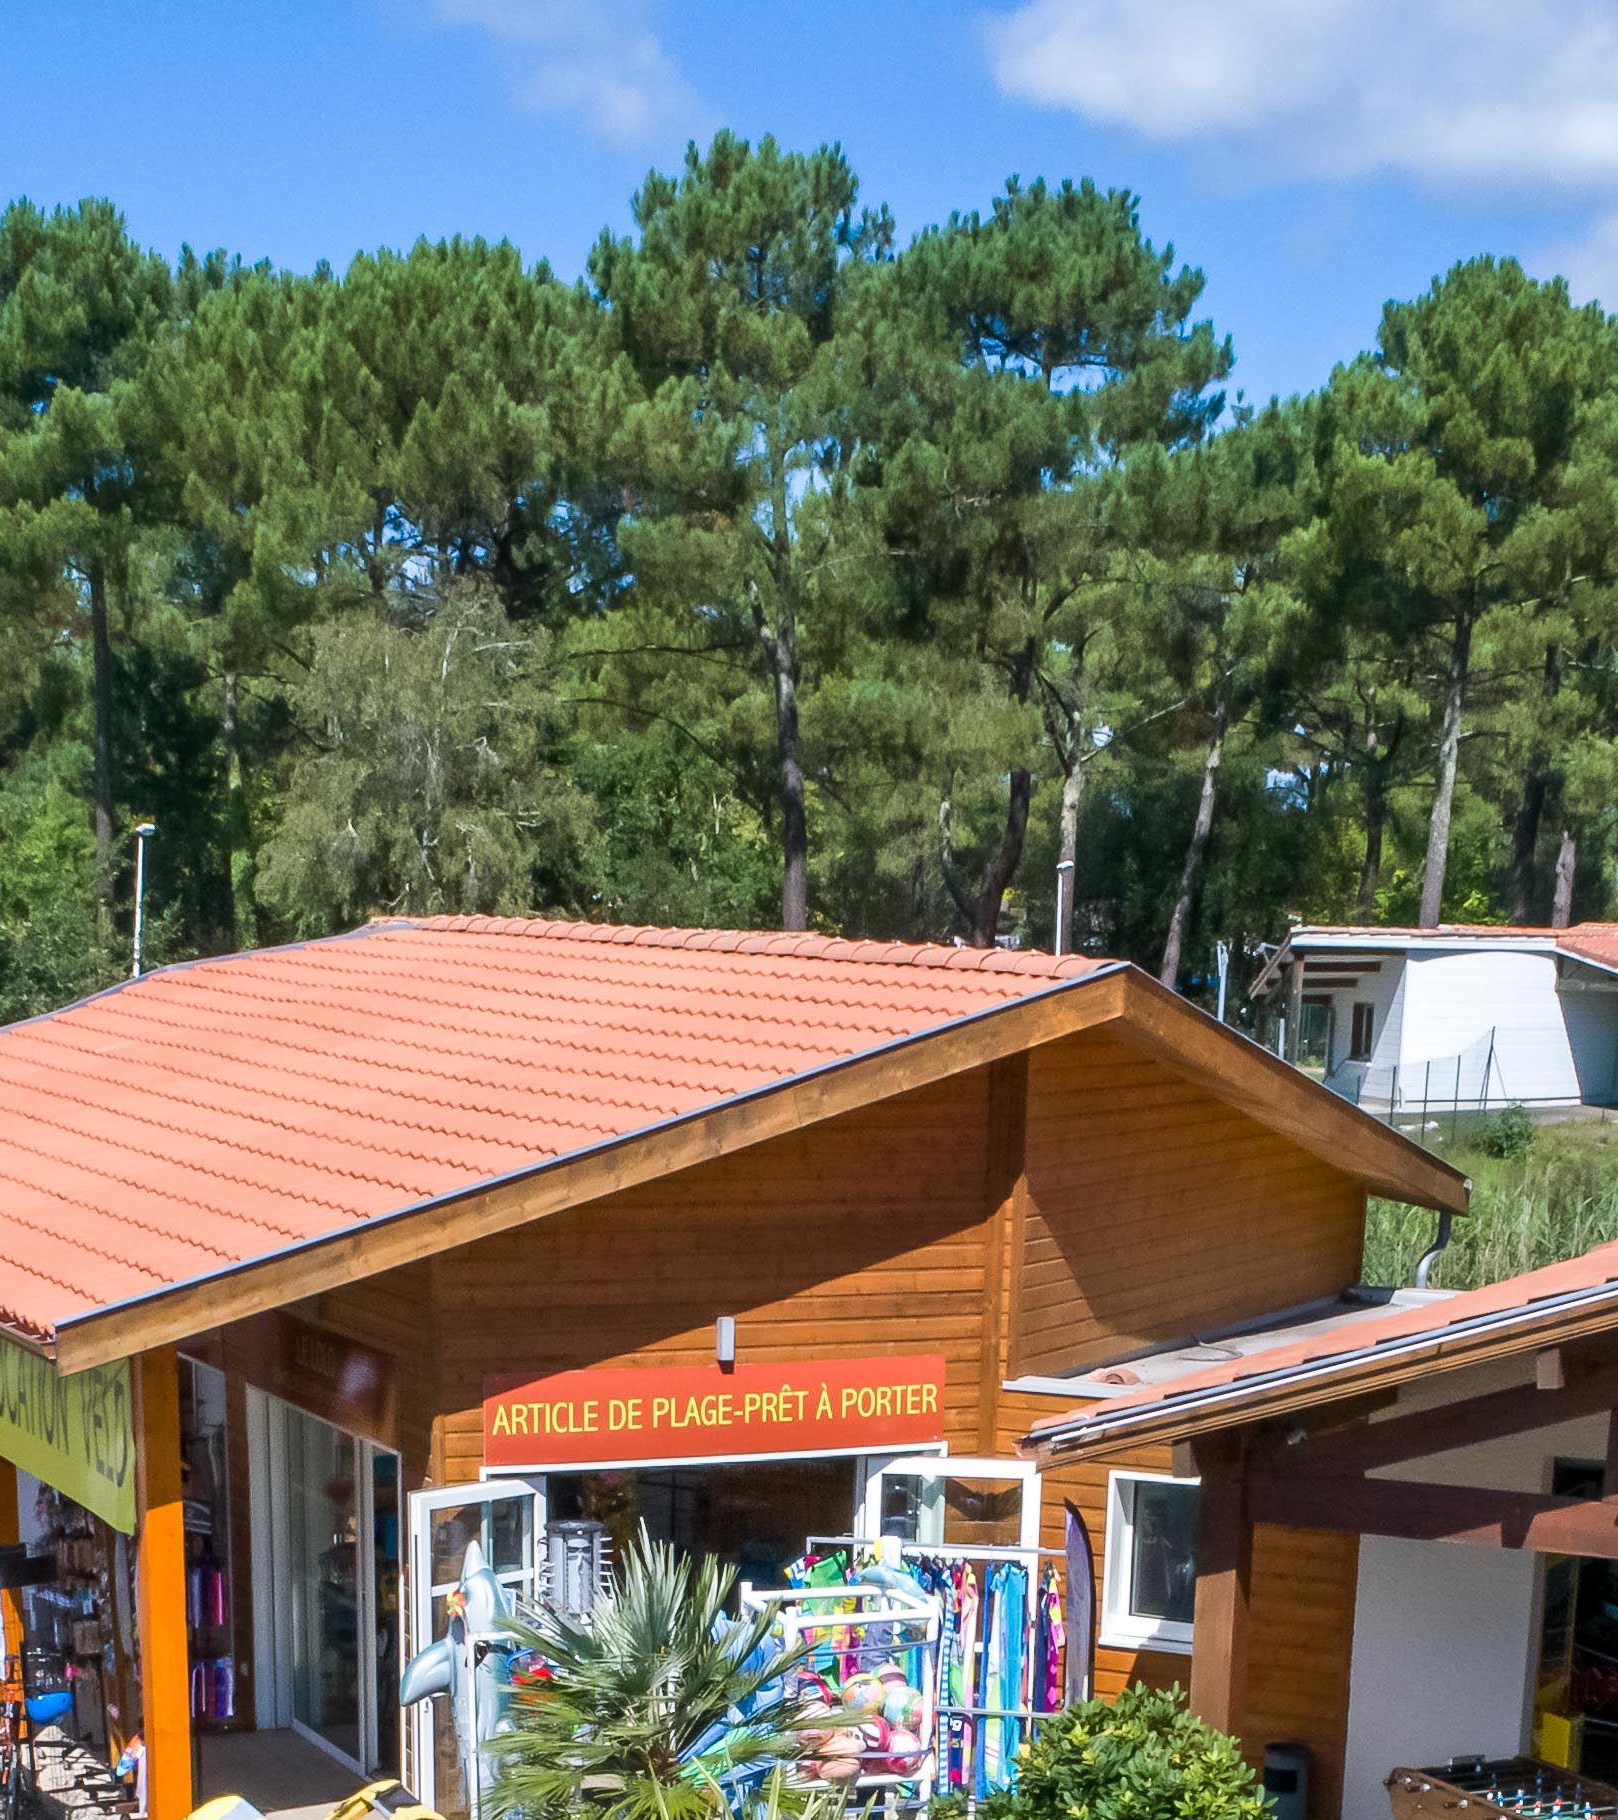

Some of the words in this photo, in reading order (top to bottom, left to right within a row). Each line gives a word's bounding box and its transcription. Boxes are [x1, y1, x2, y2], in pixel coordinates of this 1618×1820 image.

[492, 1401, 599, 1436] ARTICLE
[608, 1398, 643, 1431] DE
[652, 1384, 809, 1428] PLAGE-PRÊT
[815, 1382, 833, 1420] À
[841, 1384, 938, 1418] PORTER
